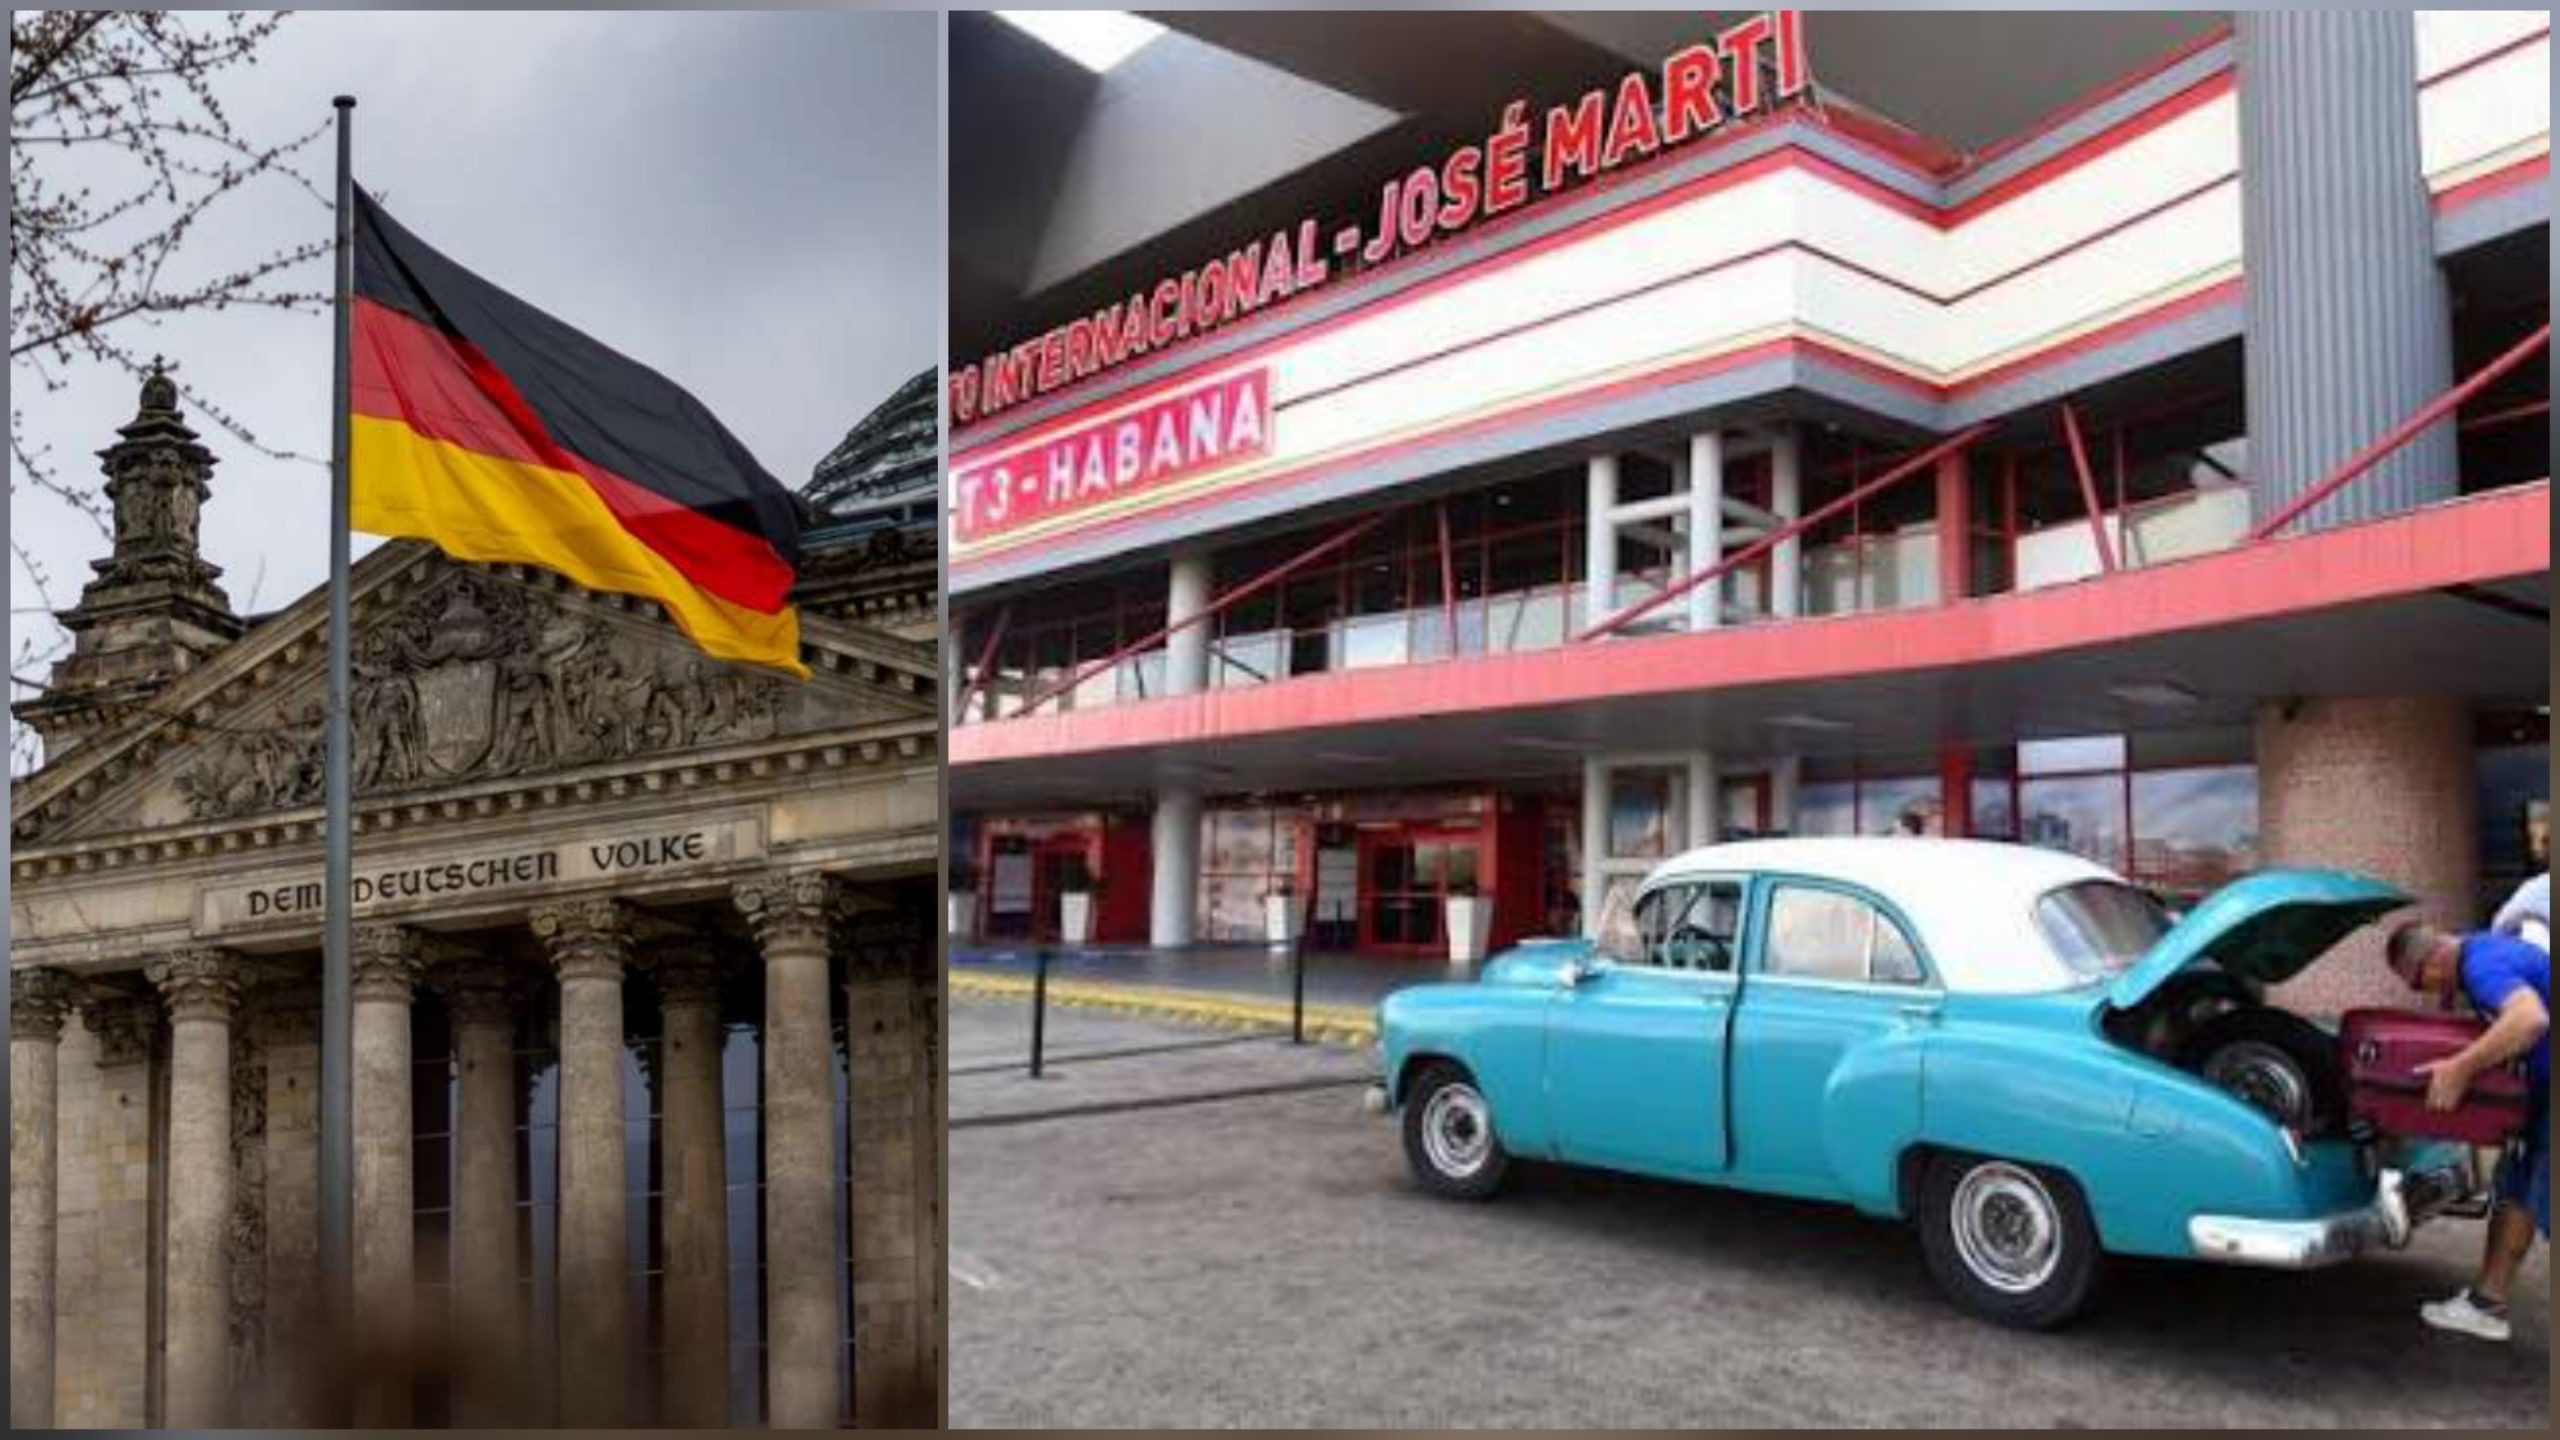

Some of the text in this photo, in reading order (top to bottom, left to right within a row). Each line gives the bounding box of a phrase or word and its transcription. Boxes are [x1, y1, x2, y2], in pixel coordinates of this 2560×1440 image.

[982, 219, 1327, 415] INTERNACIONAL
[1364, 100, 1530, 262] JOSÉ
[247, 832, 705, 916] DEM DEUTSCHEN VOLKE
